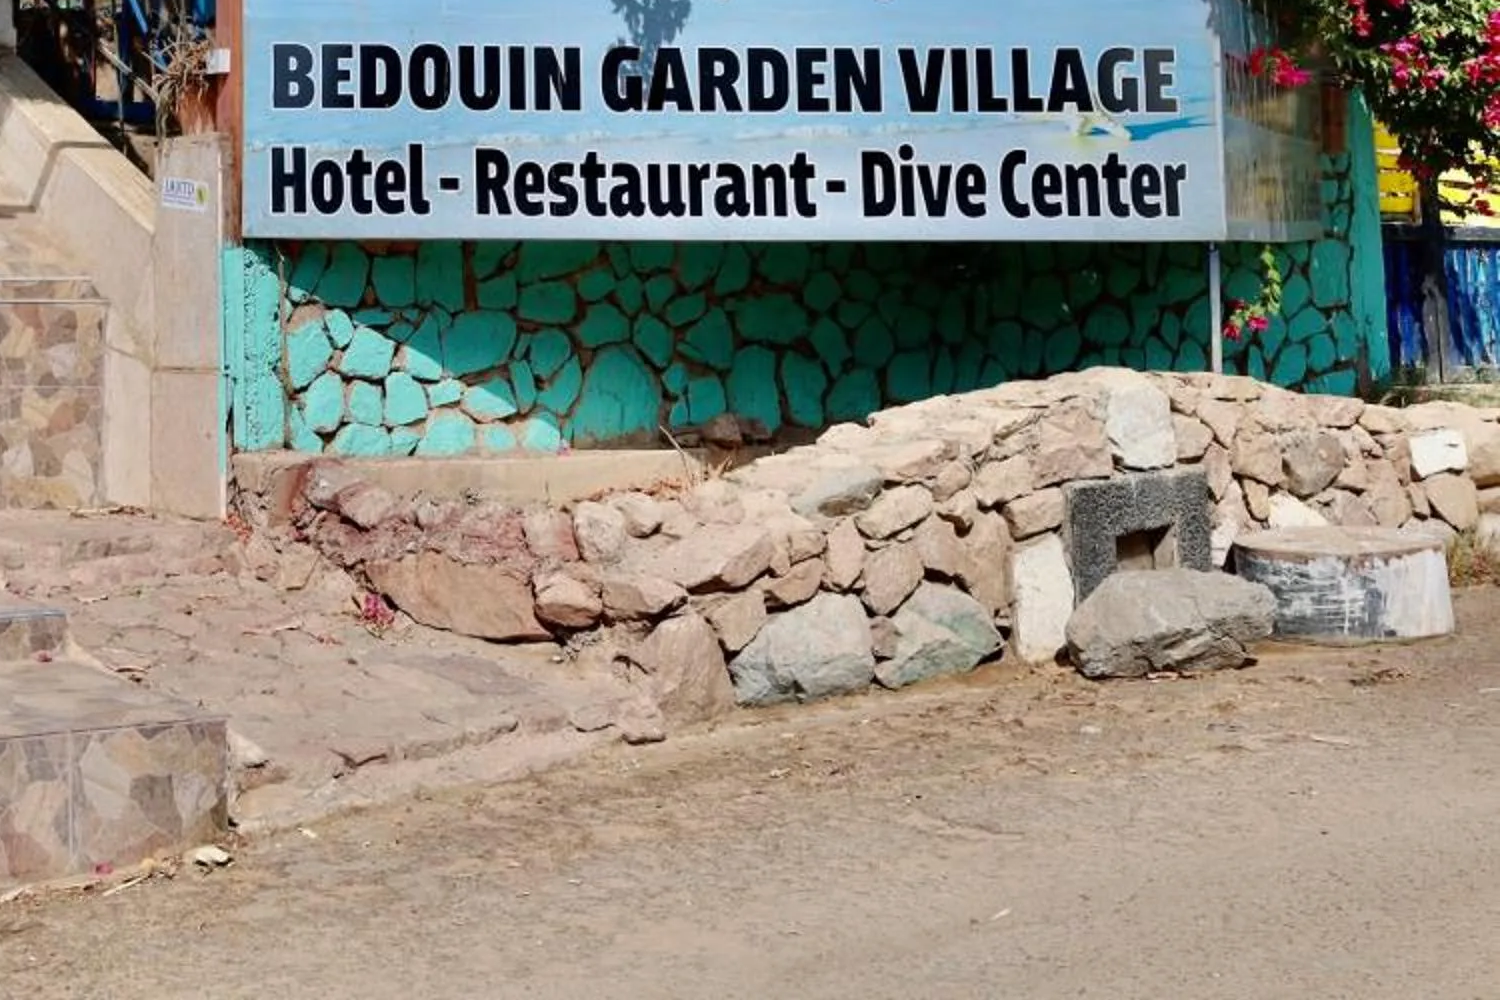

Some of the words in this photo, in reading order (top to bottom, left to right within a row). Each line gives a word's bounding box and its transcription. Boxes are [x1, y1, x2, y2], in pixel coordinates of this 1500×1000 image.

[273, 43, 581, 111] BEDOUIN
[601, 45, 882, 113] GARDEN
[898, 47, 1177, 113] VILLAGE
[271, 143, 431, 215] Hotel
[439, 177, 459, 190] -
[475, 148, 817, 218] Restaurant
[826, 180, 846, 193] -
[861, 144, 987, 218] Dive
[999, 149, 1186, 219] Center
